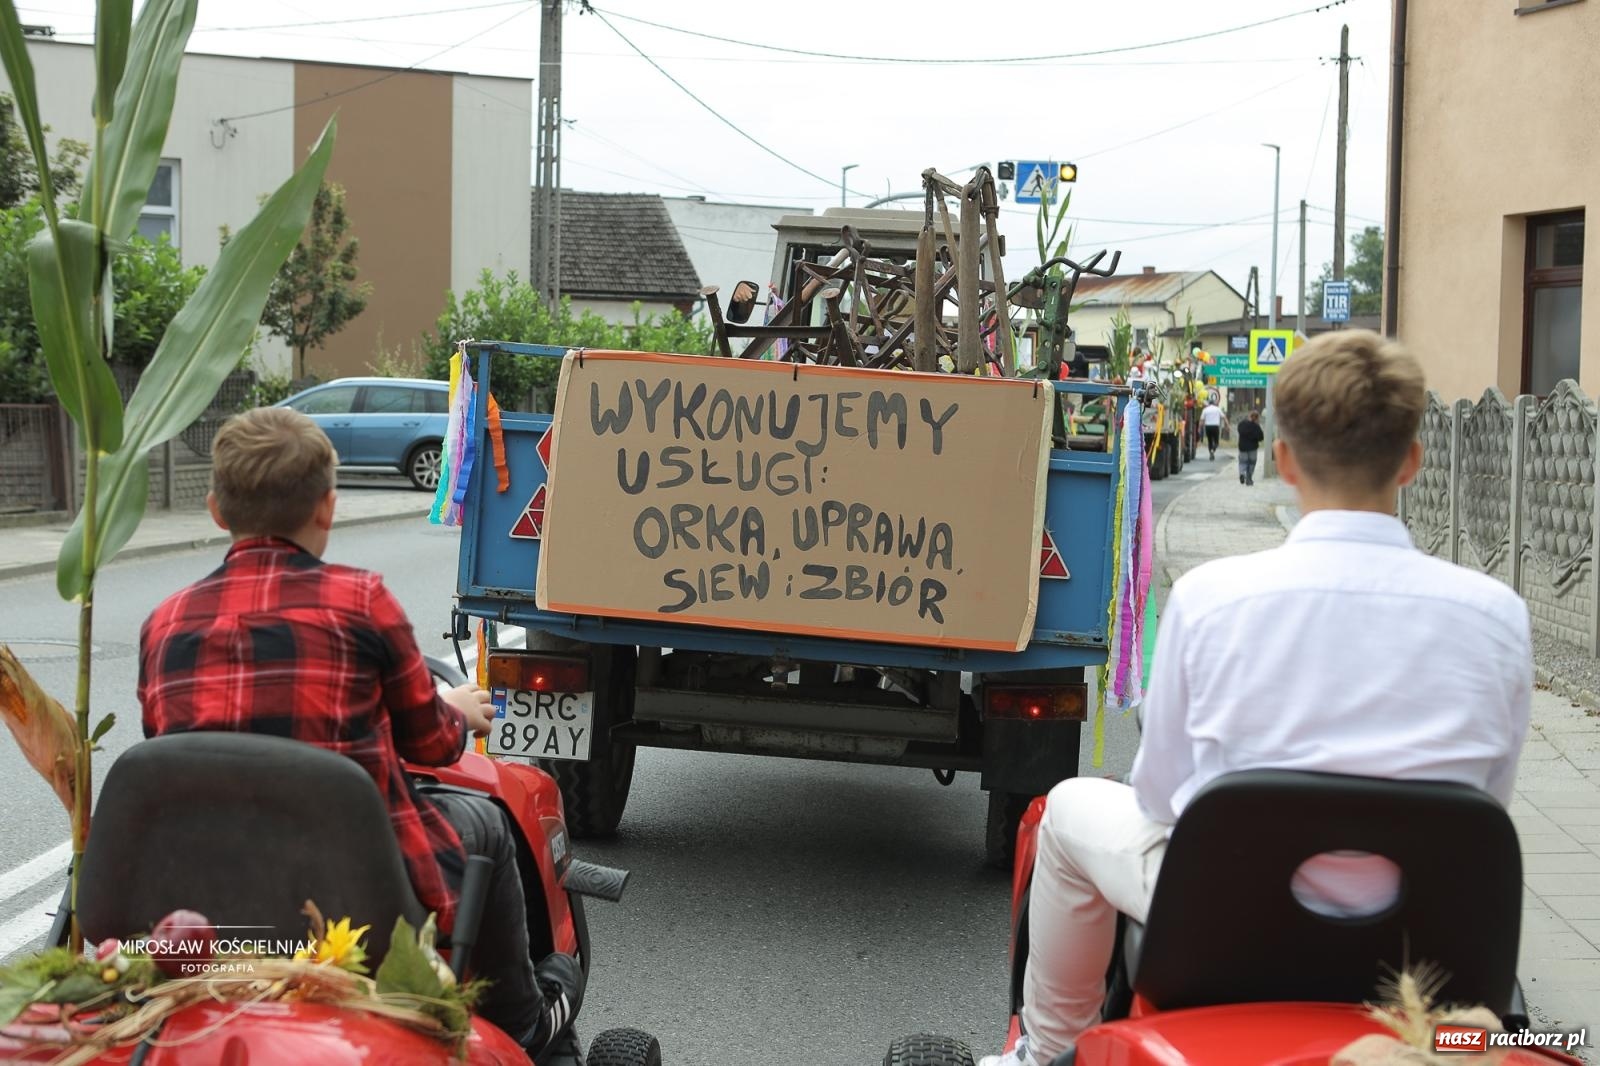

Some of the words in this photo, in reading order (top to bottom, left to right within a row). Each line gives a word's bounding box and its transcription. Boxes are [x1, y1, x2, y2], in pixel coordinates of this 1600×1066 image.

[1327, 295, 1348, 308] TIR
[590, 378, 958, 455] WYKONUJEMY
[633, 503, 781, 560] ORKA,
[793, 500, 964, 576] UPRAWA,
[658, 561, 770, 613] SIEW
[785, 574, 793, 597] i
[800, 563, 947, 624] ZBIÓR
[494, 705, 504, 714] PL
[513, 690, 578, 721] SRC
[500, 722, 585, 756] 89AY
